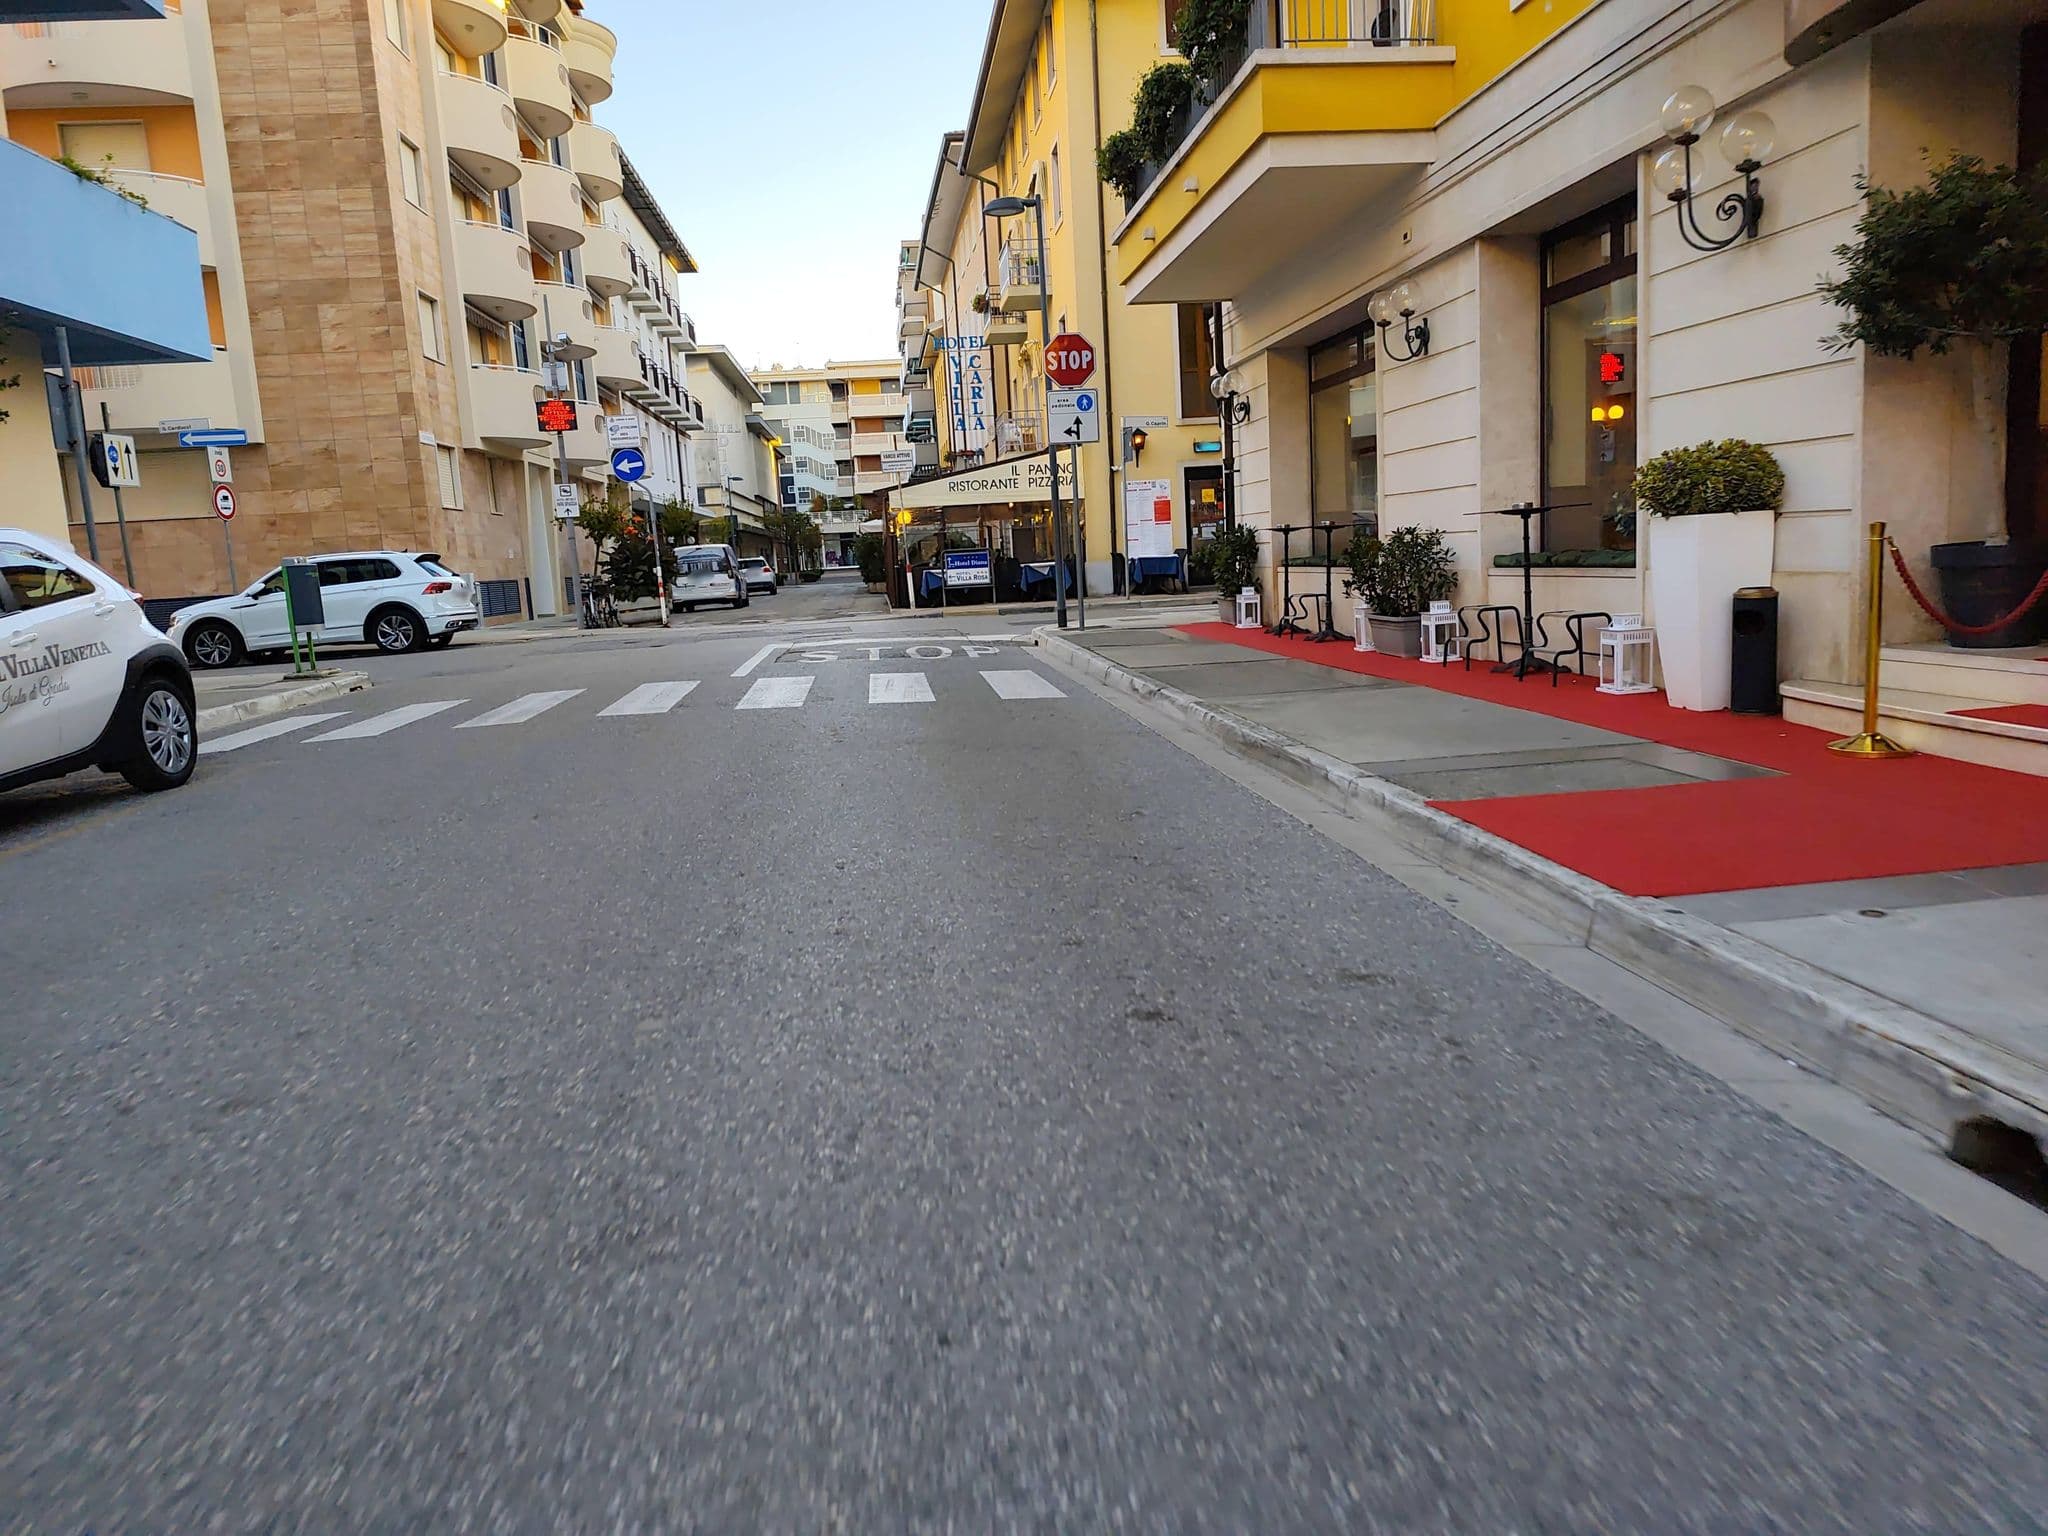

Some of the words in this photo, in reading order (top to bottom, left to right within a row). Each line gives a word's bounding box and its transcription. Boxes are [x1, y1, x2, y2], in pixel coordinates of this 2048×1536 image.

[933, 335, 987, 350] HOTEL
[1046, 350, 1093, 370] STOP
[951, 355, 966, 431] VILLA
[968, 354, 985, 430] CARLA
[1011, 465, 1020, 476] IL
[1028, 463, 1073, 476] PANNO
[948, 478, 1019, 492] RISTORANTE
[1028, 475, 1073, 488] PIZZRI
[800, 645, 1000, 663] STOP
